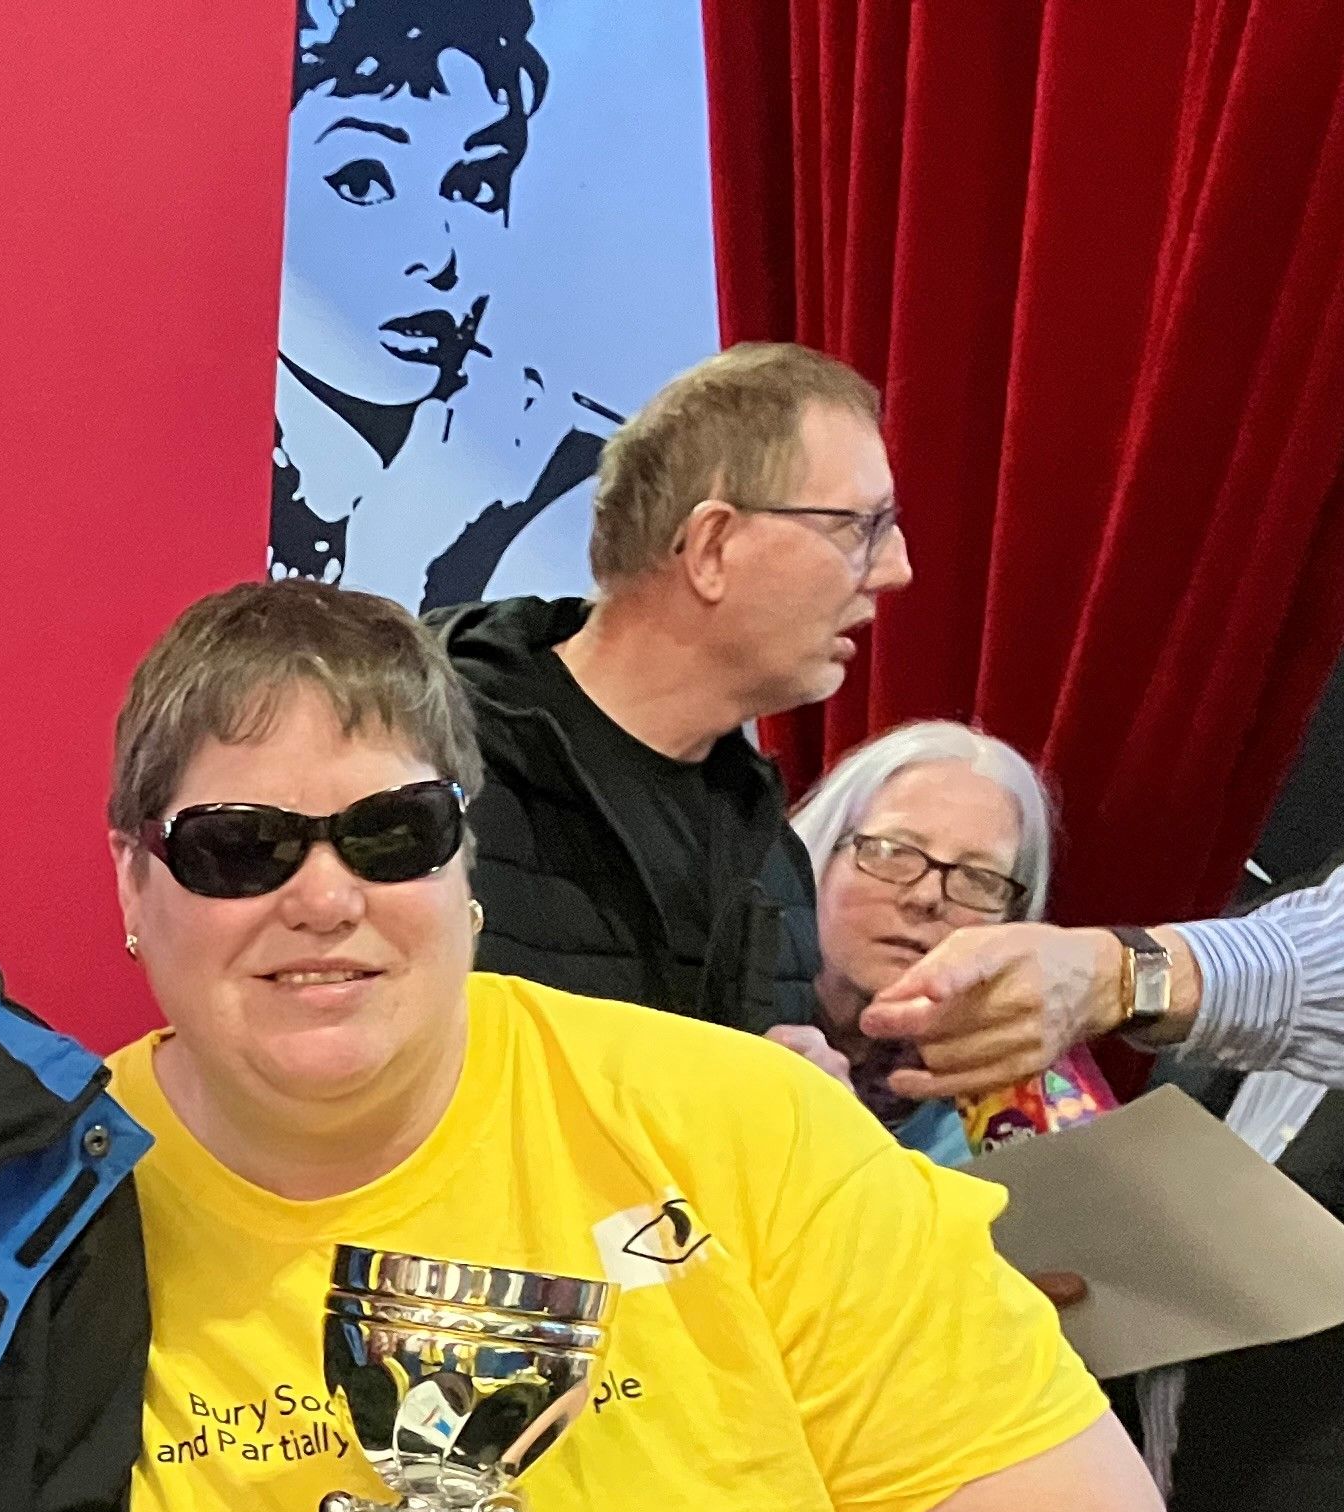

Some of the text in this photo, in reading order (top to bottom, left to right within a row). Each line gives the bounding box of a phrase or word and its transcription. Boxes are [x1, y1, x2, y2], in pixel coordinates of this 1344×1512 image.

[157, 1370, 642, 1464] and Partially ple
[189, 1391, 268, 1435] Bury
